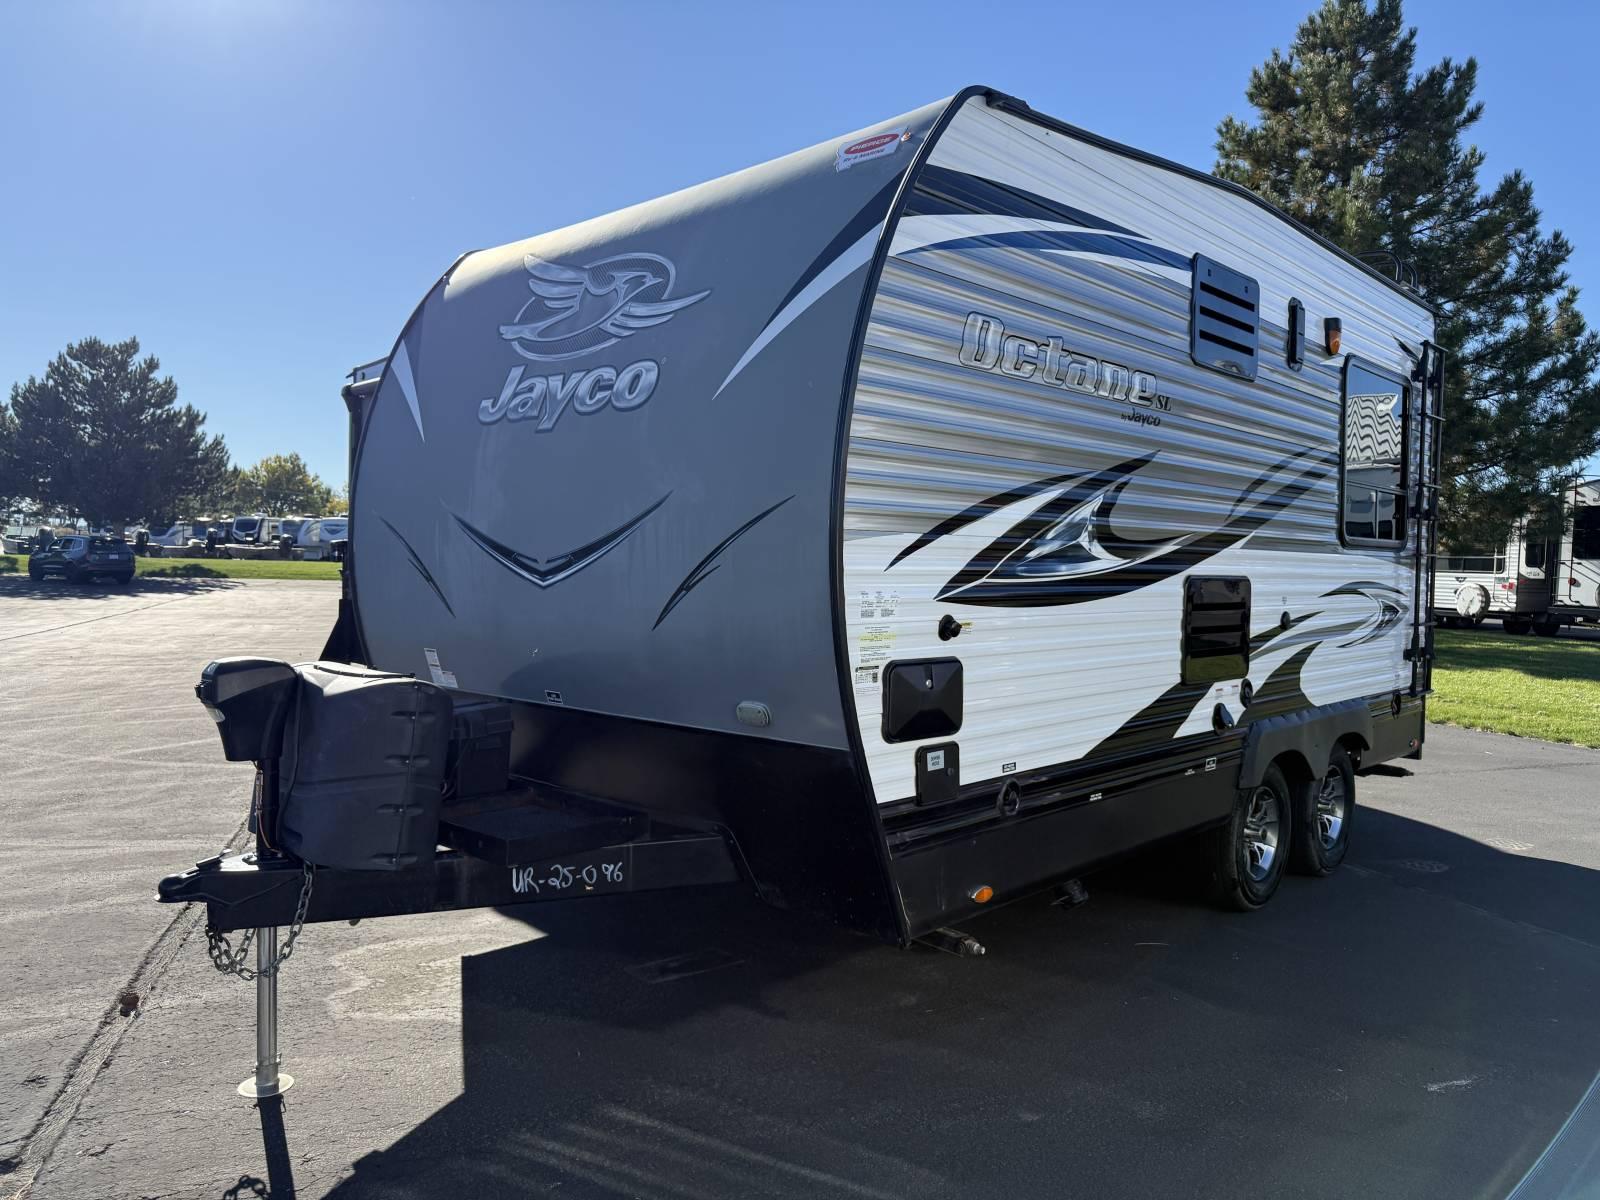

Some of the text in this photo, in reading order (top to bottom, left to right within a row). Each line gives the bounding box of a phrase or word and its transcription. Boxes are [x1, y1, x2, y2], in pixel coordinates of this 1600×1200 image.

[478, 358, 660, 434] Jayco
[958, 310, 1172, 412] Octane SL
[1127, 407, 1161, 428] Jayco
